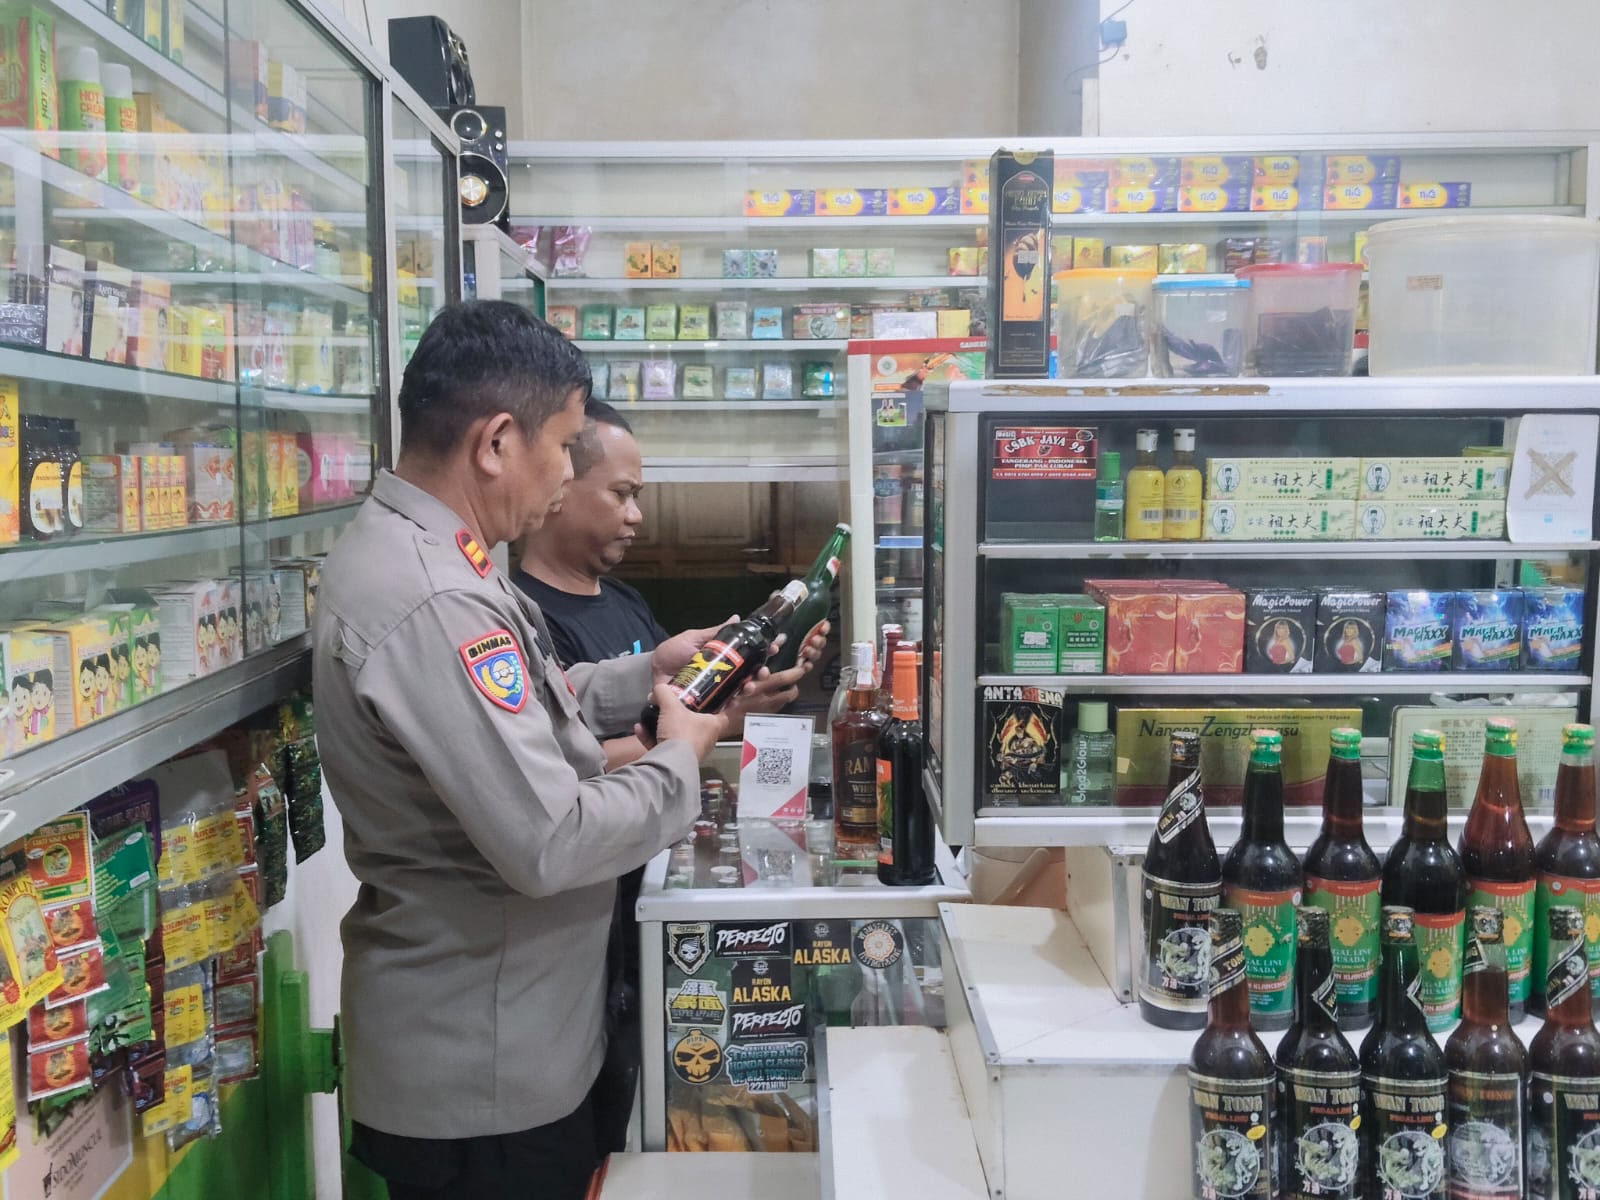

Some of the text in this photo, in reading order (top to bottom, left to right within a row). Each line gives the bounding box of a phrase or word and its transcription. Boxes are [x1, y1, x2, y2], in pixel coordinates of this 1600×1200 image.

[1004, 435, 1085, 453] CSBK JAYA 99
[1252, 593, 1312, 609] MagicPower
[1320, 593, 1381, 609] MagicPower
[468, 637, 511, 658] BINMAS
[1076, 740, 1087, 801] Glad2Glow
[716, 922, 789, 952] PERFECTO
[793, 948, 851, 964] ALASKA
[733, 986, 791, 1003] ALASKA
[732, 1004, 805, 1033] PERFECTO
[729, 1060, 763, 1072] HONDA
[1222, 1095, 1263, 1112] TONG
[1409, 1094, 1445, 1112] TONG
